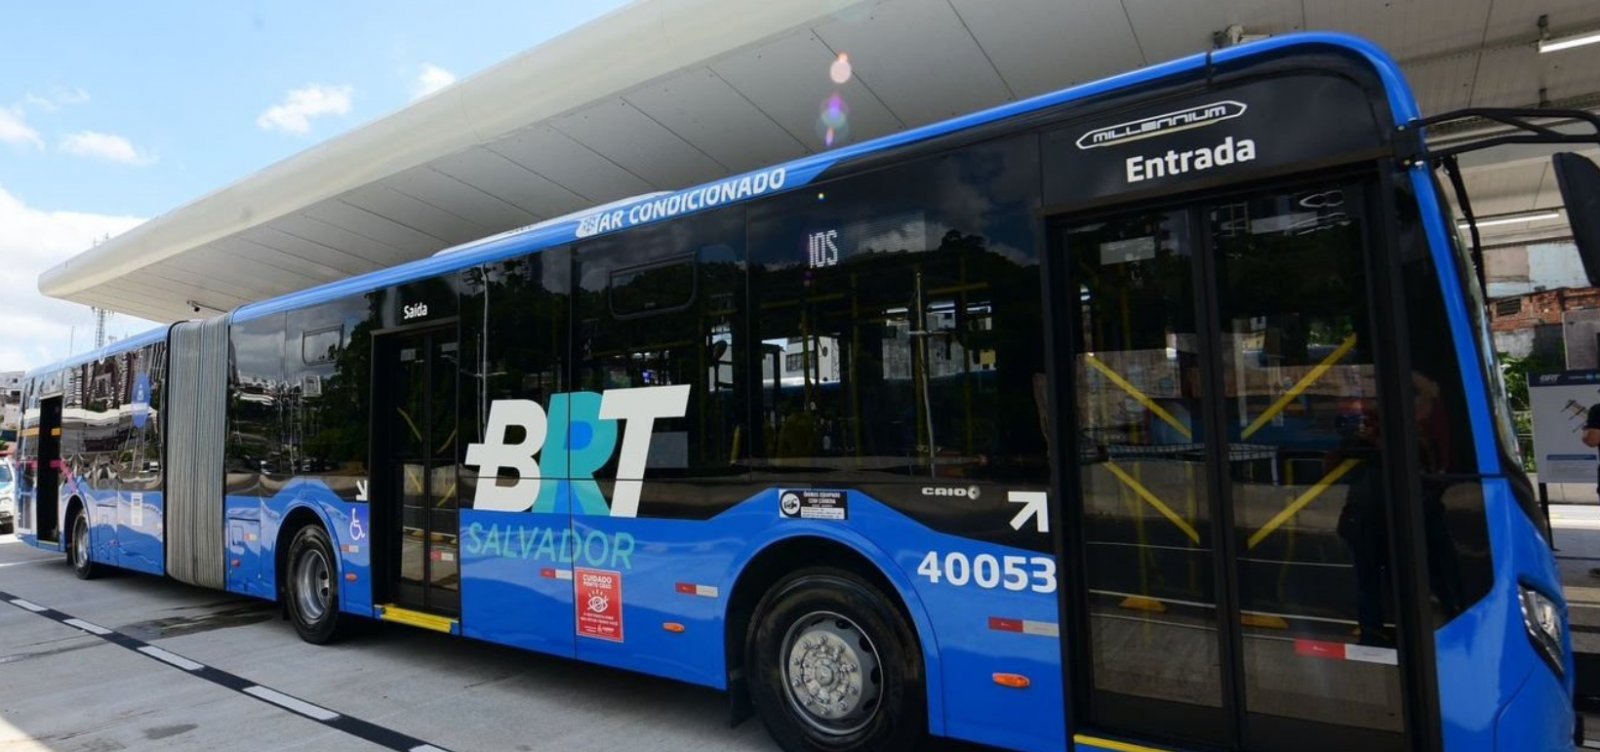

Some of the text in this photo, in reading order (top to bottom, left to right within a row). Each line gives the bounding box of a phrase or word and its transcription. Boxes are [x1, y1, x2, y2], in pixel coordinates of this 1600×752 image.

[1093, 105, 1226, 143] MILLENNIUM
[1126, 136, 1256, 183] Entrada
[598, 167, 786, 232] AR CONDICIONADO
[403, 302, 428, 319] Saída
[464, 384, 691, 518] BRT
[921, 487, 967, 497] CAIO
[466, 522, 636, 570] SALVADOR
[583, 574, 612, 584] CUIDADO
[917, 551, 1058, 593] 40053
